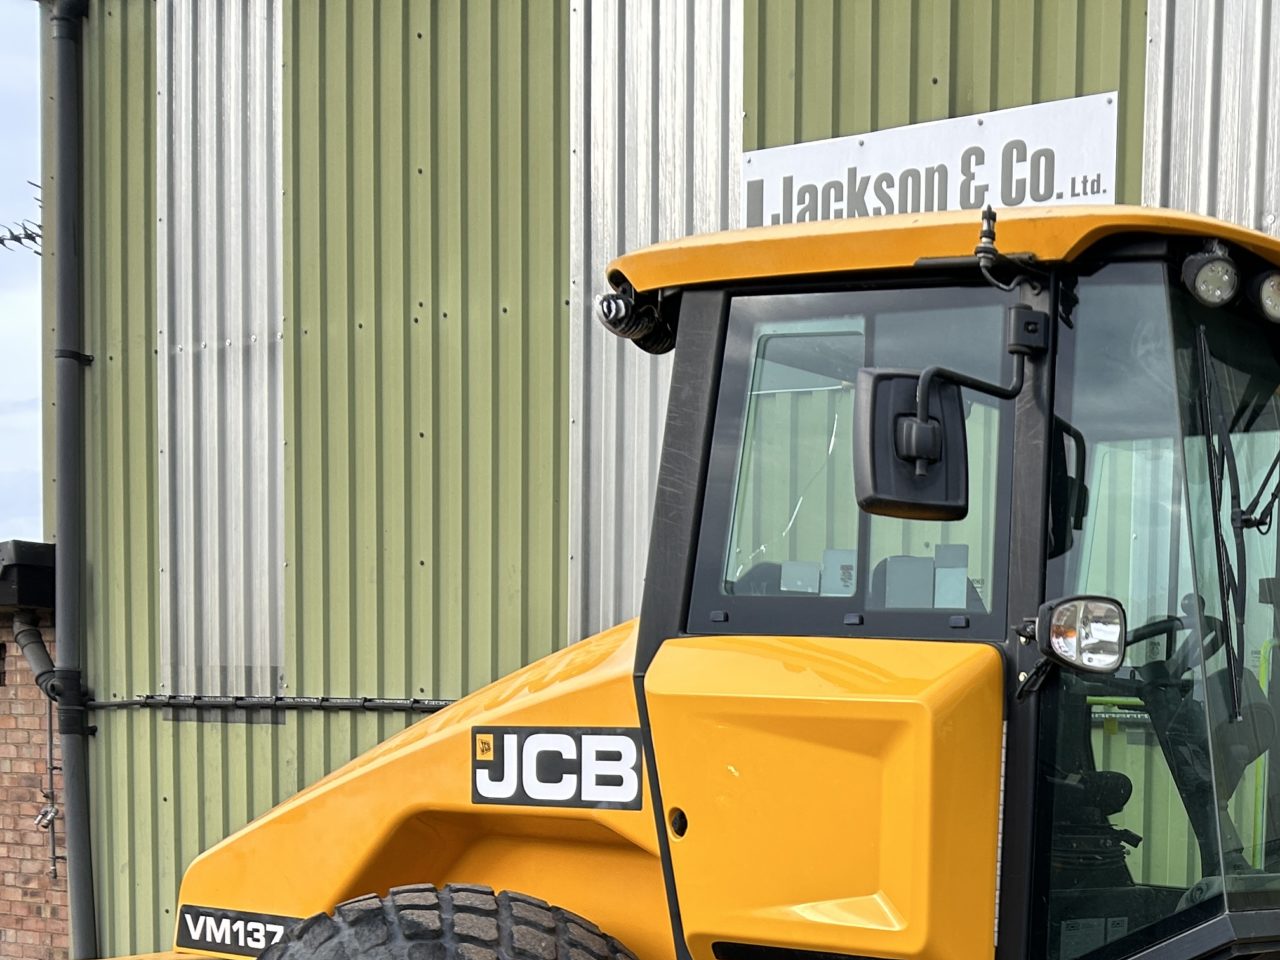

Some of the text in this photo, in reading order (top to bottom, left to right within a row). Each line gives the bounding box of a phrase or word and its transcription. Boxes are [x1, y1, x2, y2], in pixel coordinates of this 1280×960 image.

[771, 163, 948, 225] Jackson
[960, 146, 989, 210] &
[1001, 139, 1063, 206] Co.
[1071, 173, 1107, 197] Ltd.
[476, 733, 638, 802] JCB
[184, 913, 285, 949] VM137
